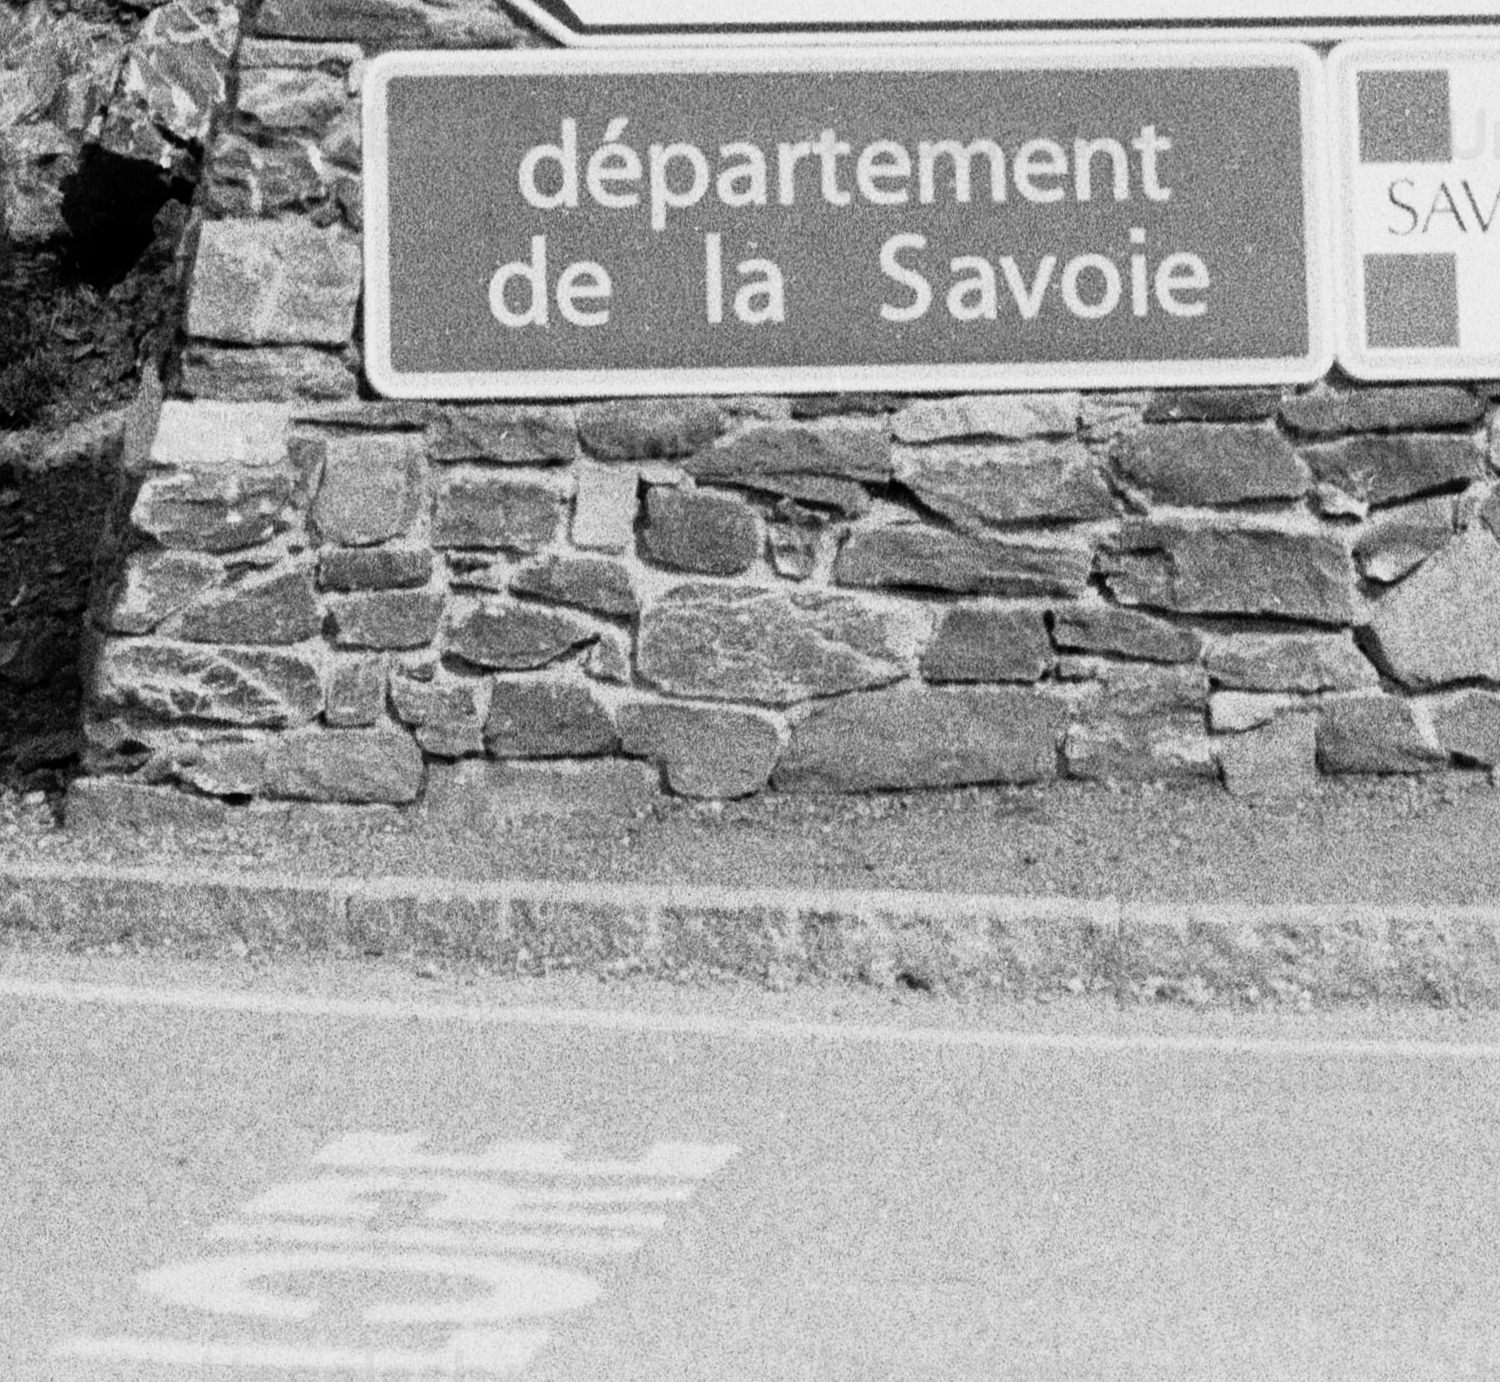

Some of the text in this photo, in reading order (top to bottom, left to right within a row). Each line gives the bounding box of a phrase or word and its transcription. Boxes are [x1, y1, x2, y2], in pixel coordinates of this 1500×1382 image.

[516, 114, 1176, 232] département
[486, 225, 1213, 329] de la Savoie
